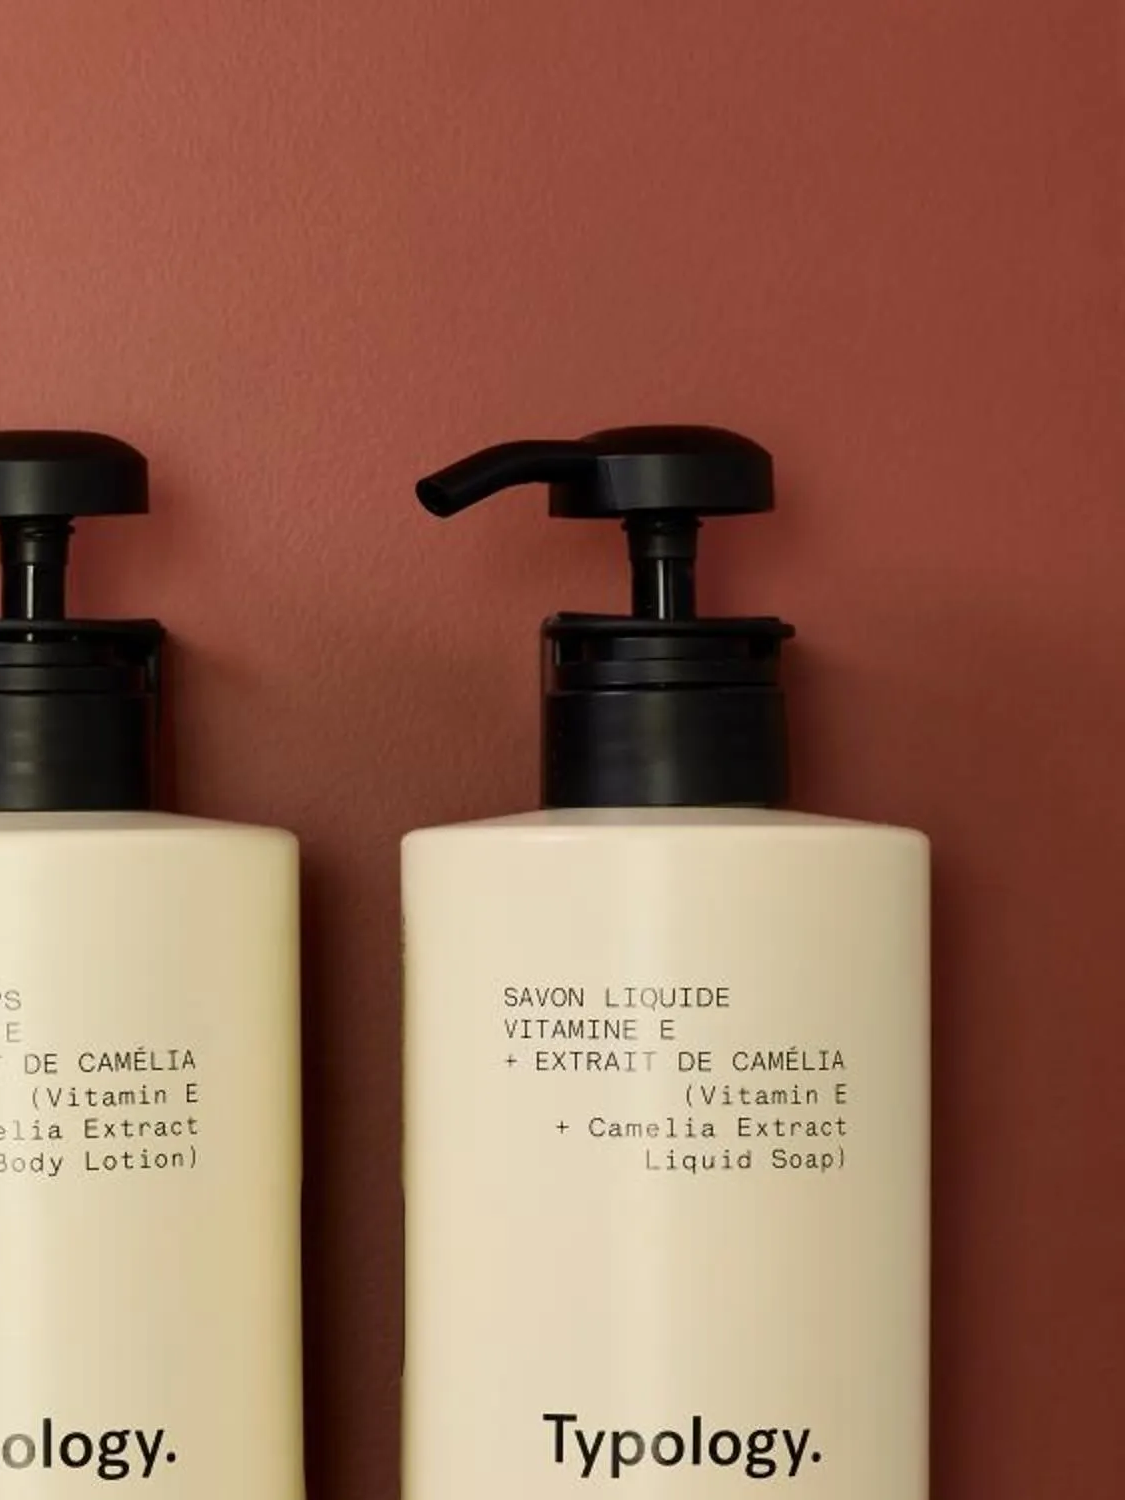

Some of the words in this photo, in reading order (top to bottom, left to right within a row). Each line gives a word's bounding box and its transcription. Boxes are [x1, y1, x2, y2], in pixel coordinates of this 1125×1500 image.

[504, 987, 585, 1007] SAVON
[605, 987, 730, 1011] LIQUIDE
[6, 1022, 21, 1043] E
[504, 1019, 638, 1040] VITAMINE
[660, 1020, 676, 1040] E
[24, 1054, 58, 1075] DE
[78, 1047, 196, 1073] CAMÉLIA
[505, 1055, 517, 1068] +
[536, 1052, 658, 1072] EXTRAIT
[679, 1052, 712, 1072] DE
[732, 1046, 846, 1071] CAMÉLIA
[32, 1087, 166, 1109] (Vitamin
[186, 1084, 198, 1103] E
[686, 1084, 818, 1107] (Vitamin
[836, 1084, 847, 1103] E
[84, 1116, 198, 1139] Extract
[556, 1120, 569, 1134] +
[588, 1117, 716, 1138] Camelia
[738, 1117, 847, 1137] Extract
[86, 1147, 197, 1171] Lotion)
[646, 1149, 752, 1173] Liquid
[772, 1148, 845, 1173] Soap)
[542, 1414, 821, 1478] Typology.
